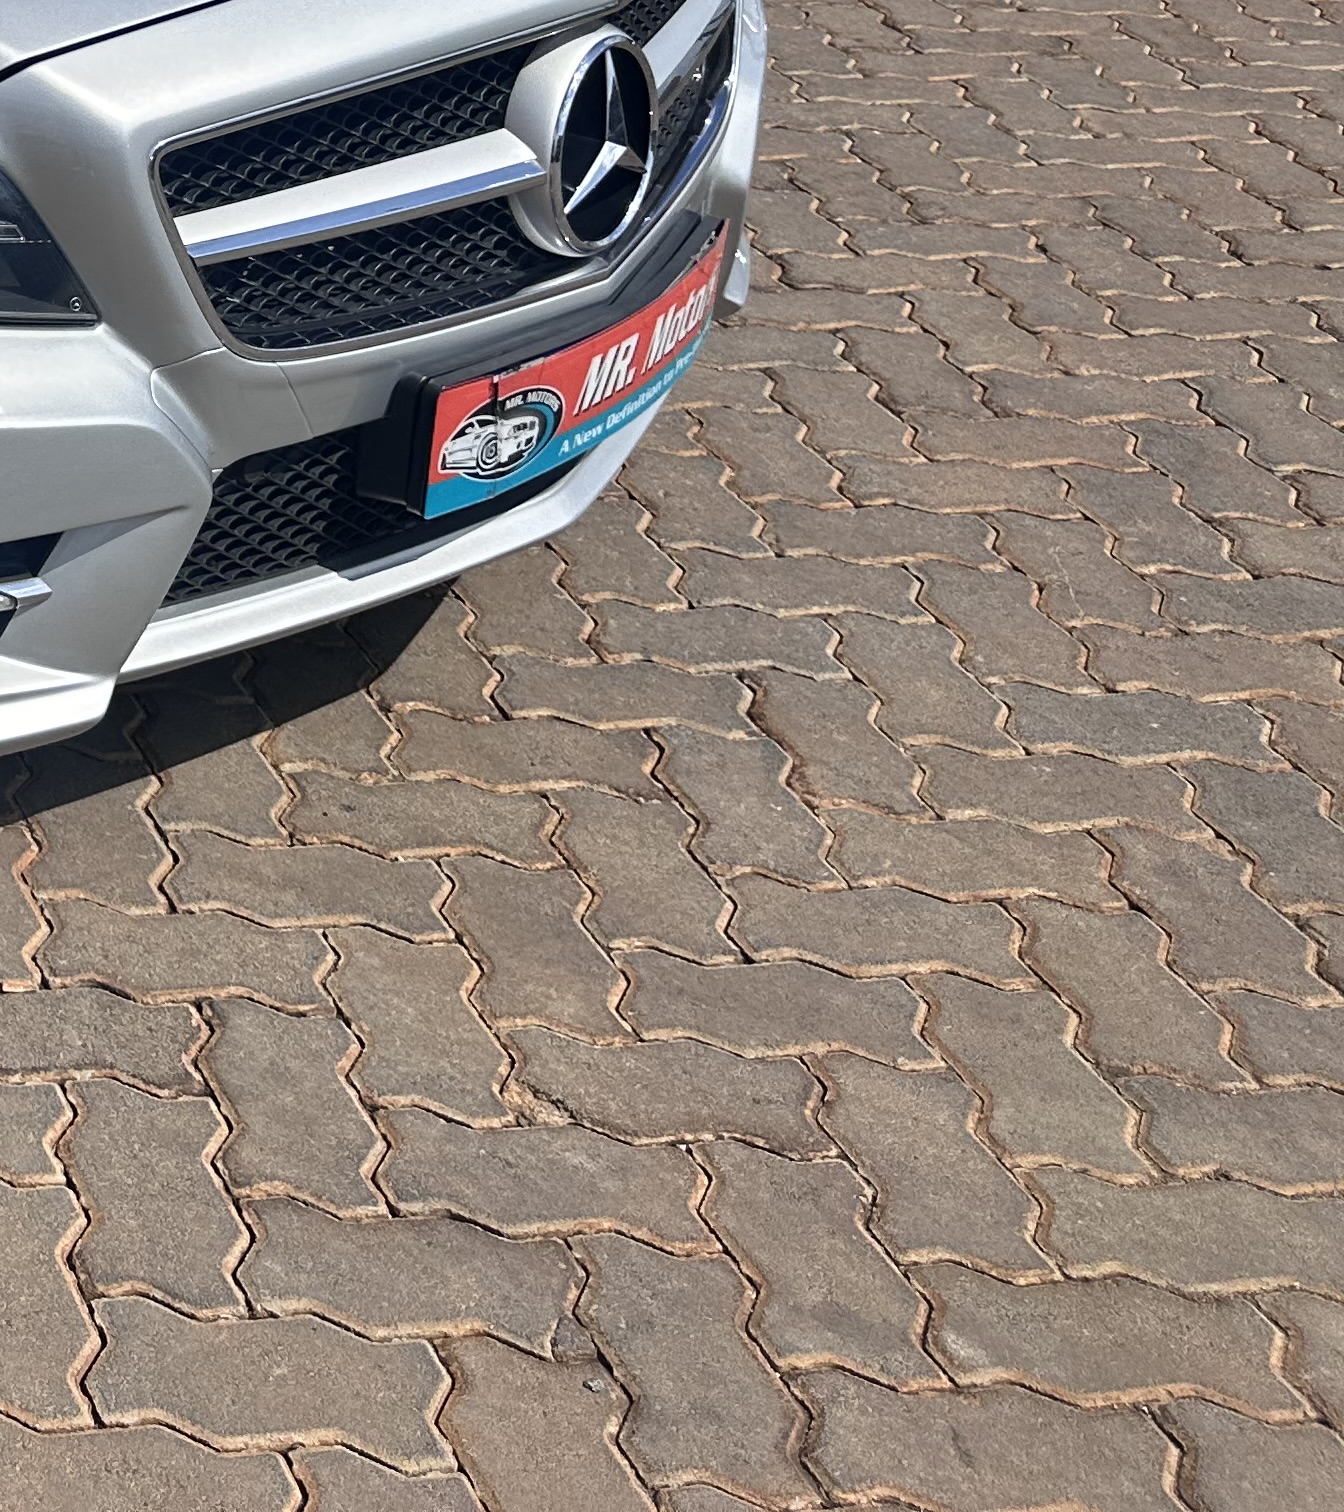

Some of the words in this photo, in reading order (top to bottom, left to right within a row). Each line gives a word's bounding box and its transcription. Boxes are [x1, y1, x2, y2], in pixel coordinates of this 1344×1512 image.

[573, 332, 640, 417] MR.
[504, 394, 524, 411] MR.
[558, 439, 569, 457] A
[572, 425, 604, 449] New
